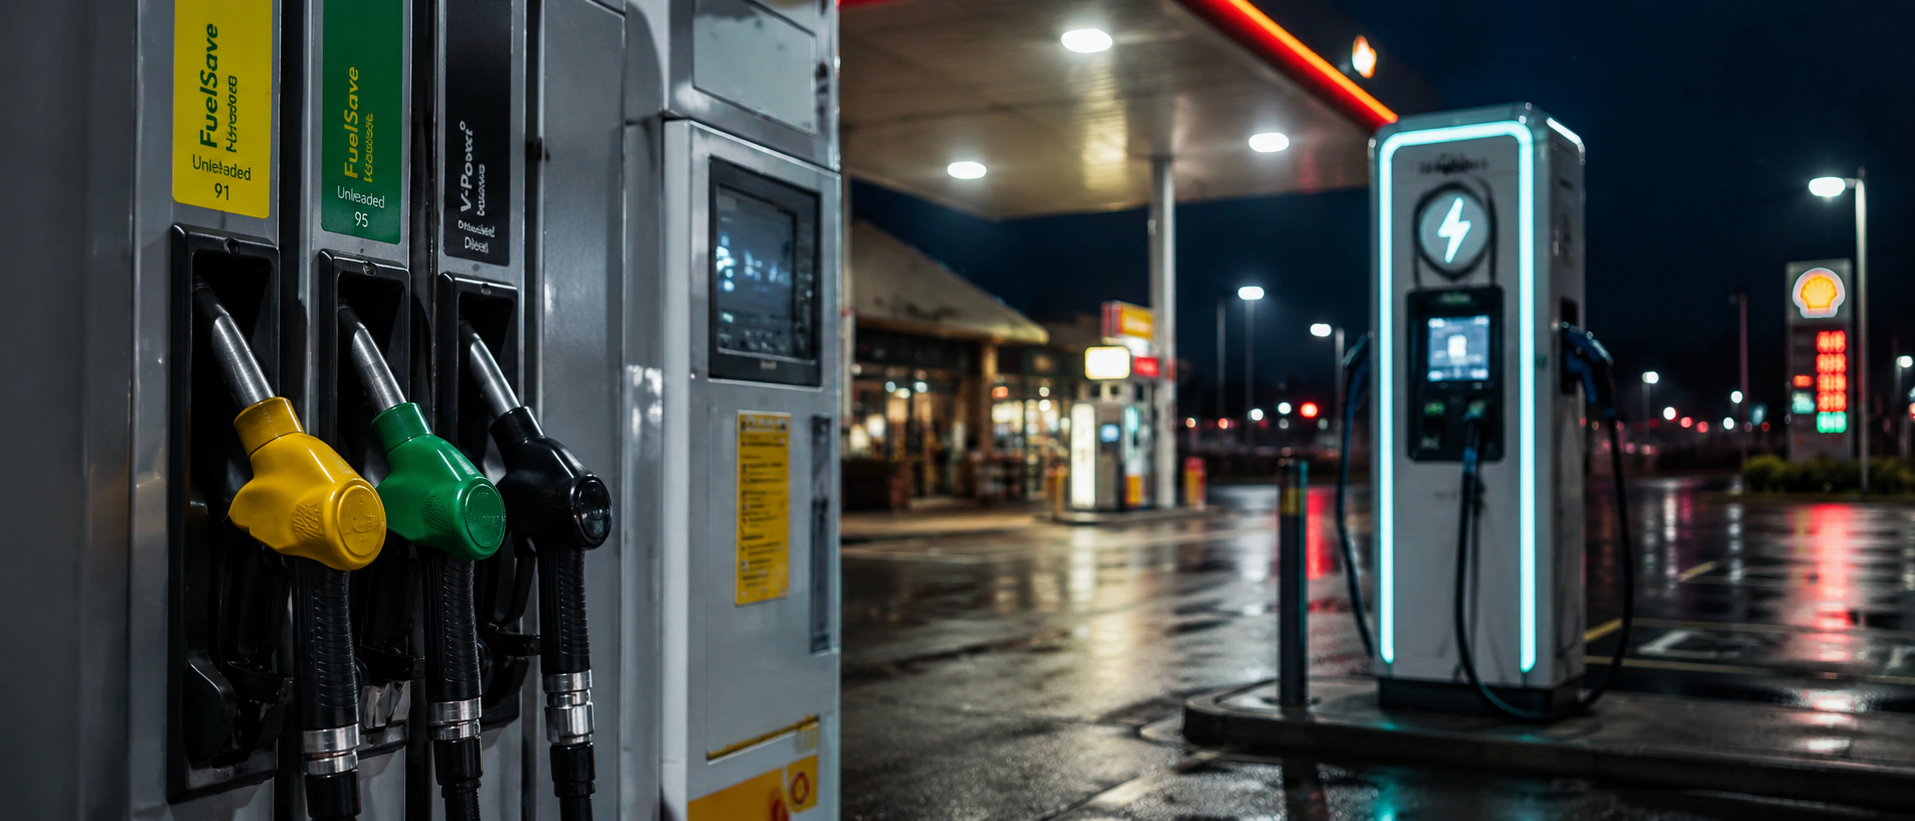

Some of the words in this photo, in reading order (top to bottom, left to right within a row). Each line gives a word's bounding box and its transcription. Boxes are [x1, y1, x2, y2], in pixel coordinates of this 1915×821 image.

[199, 23, 218, 149] FuelSave
[344, 66, 359, 179] FuelSave
[214, 182, 229, 201] 91
[337, 185, 385, 209] Unleaded
[354, 211, 369, 228] 95
